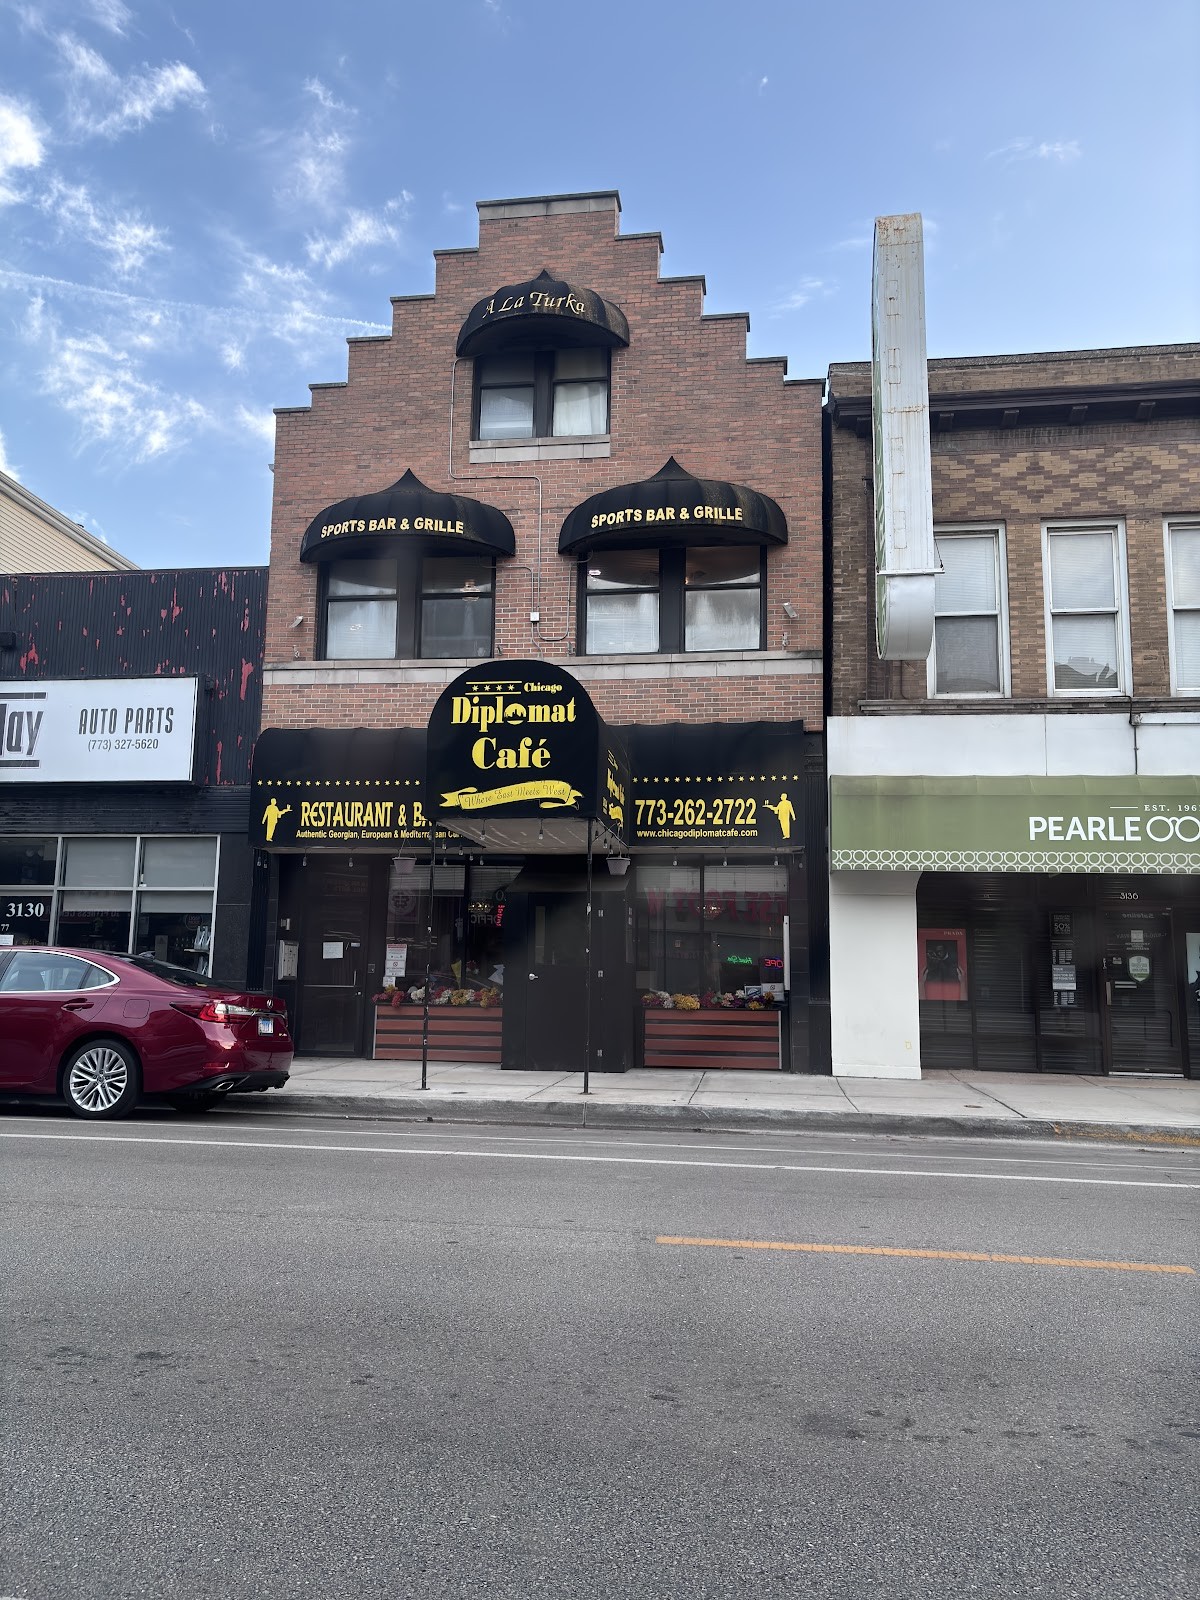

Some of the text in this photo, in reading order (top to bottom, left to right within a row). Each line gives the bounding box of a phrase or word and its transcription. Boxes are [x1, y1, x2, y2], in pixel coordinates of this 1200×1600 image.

[482, 291, 585, 318] A La Turka
[591, 505, 743, 528] SPORTS BAR & GRILLE
[320, 517, 464, 538] SPORTS BAR & GRILLE
[523, 682, 563, 694] Chicago
[78, 707, 174, 735] AUTO PARTS
[451, 695, 577, 732] Diplomat
[88, 738, 159, 752] (773) 327-5620
[471, 736, 551, 769] Café
[495, 789, 514, 800] East
[515, 786, 540, 797] Meets
[542, 784, 566, 796] West
[301, 801, 394, 827] RESTAURANT
[397, 803, 407, 827] &
[634, 798, 757, 826] 773-262-2722
[1144, 804, 1170, 812] EST.
[296, 829, 327, 838] Authentic
[328, 829, 360, 840] Georgian,
[361, 830, 392, 840] European
[394, 830, 399, 838] &
[400, 829, 447, 839] Mediterraean
[636, 828, 758, 839] www.chicagodiplomatcafe.com
[1028, 816, 1142, 841] PEARLE
[1119, 892, 1139, 900] 3136
[5, 902, 45, 918] 3130
